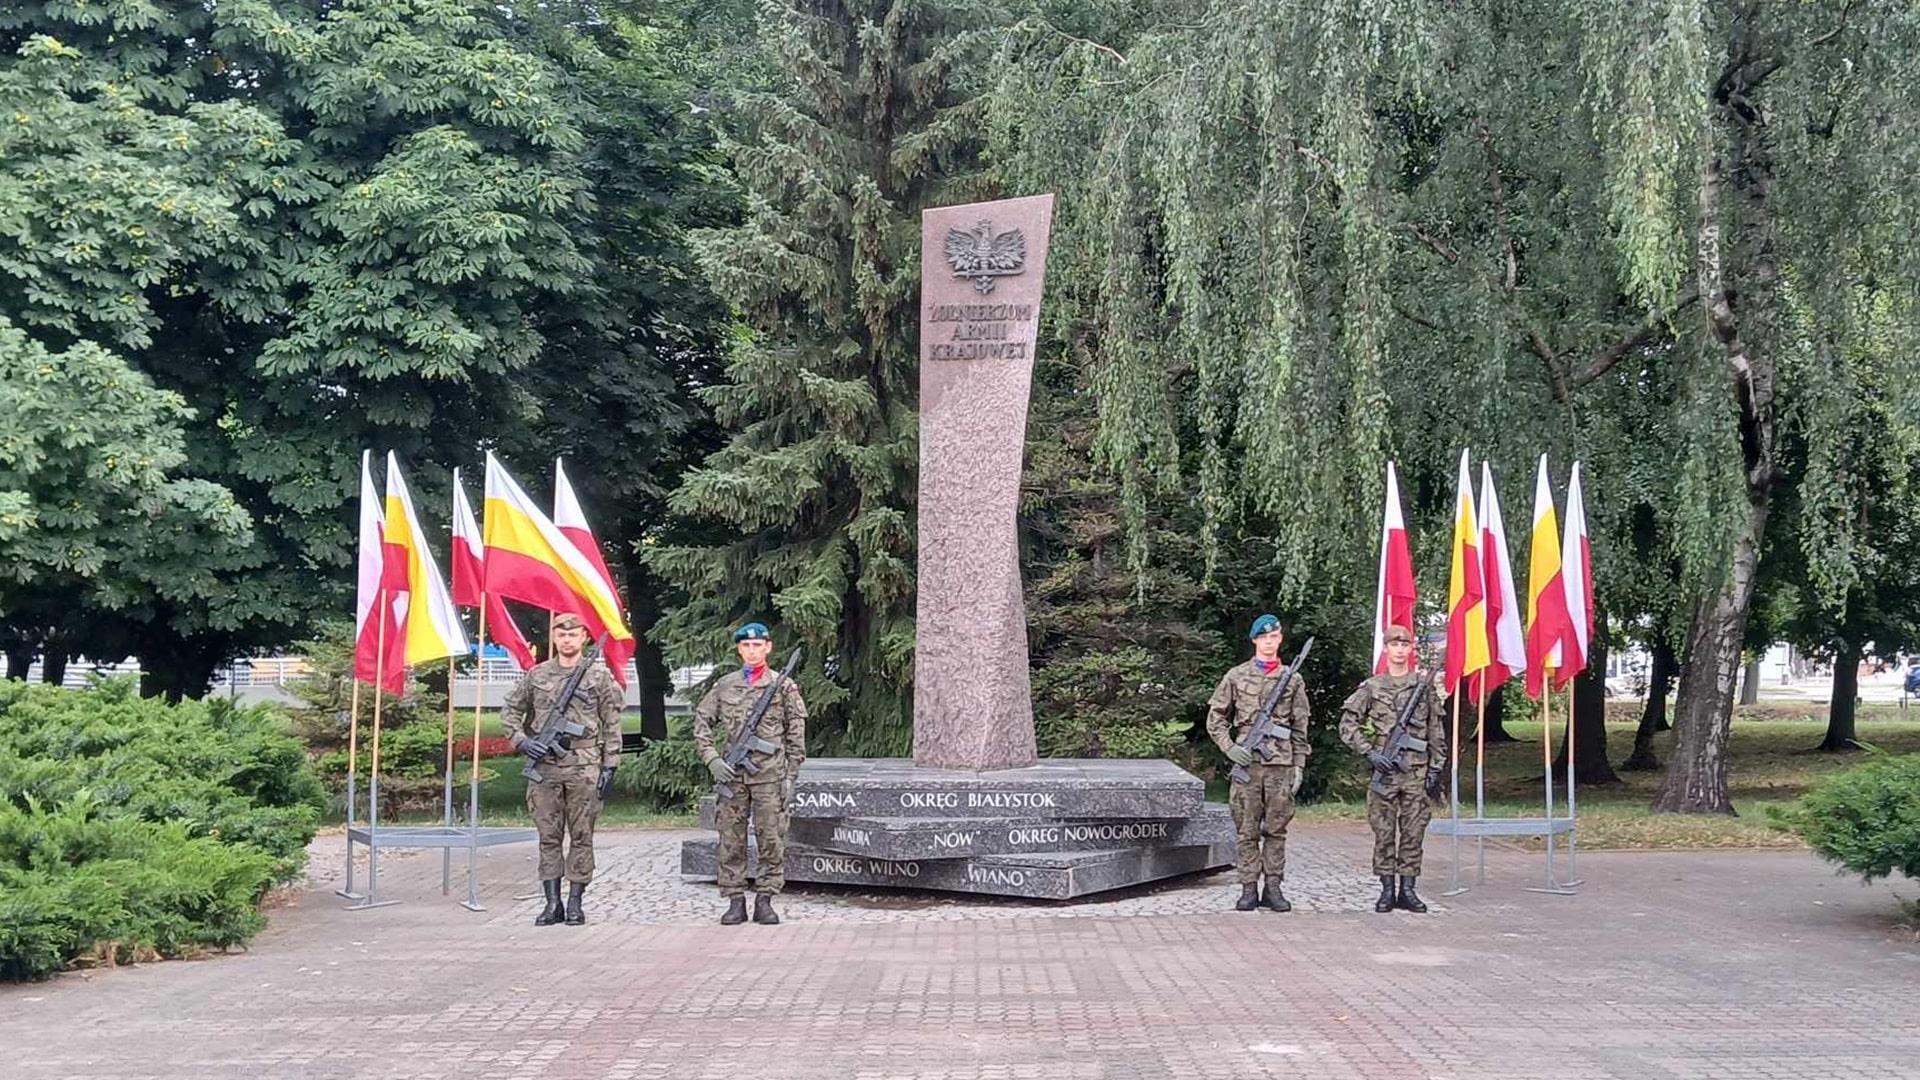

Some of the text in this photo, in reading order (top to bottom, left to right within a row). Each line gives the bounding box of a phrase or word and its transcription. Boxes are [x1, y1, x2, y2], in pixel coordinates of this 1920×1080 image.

[951, 323, 1007, 341] ARMII
[929, 342, 1026, 361] KRAJOWEJ
[901, 792, 1055, 810] OKRĘG BIAŁYSTOK
[869, 860, 919, 877] WILNO
